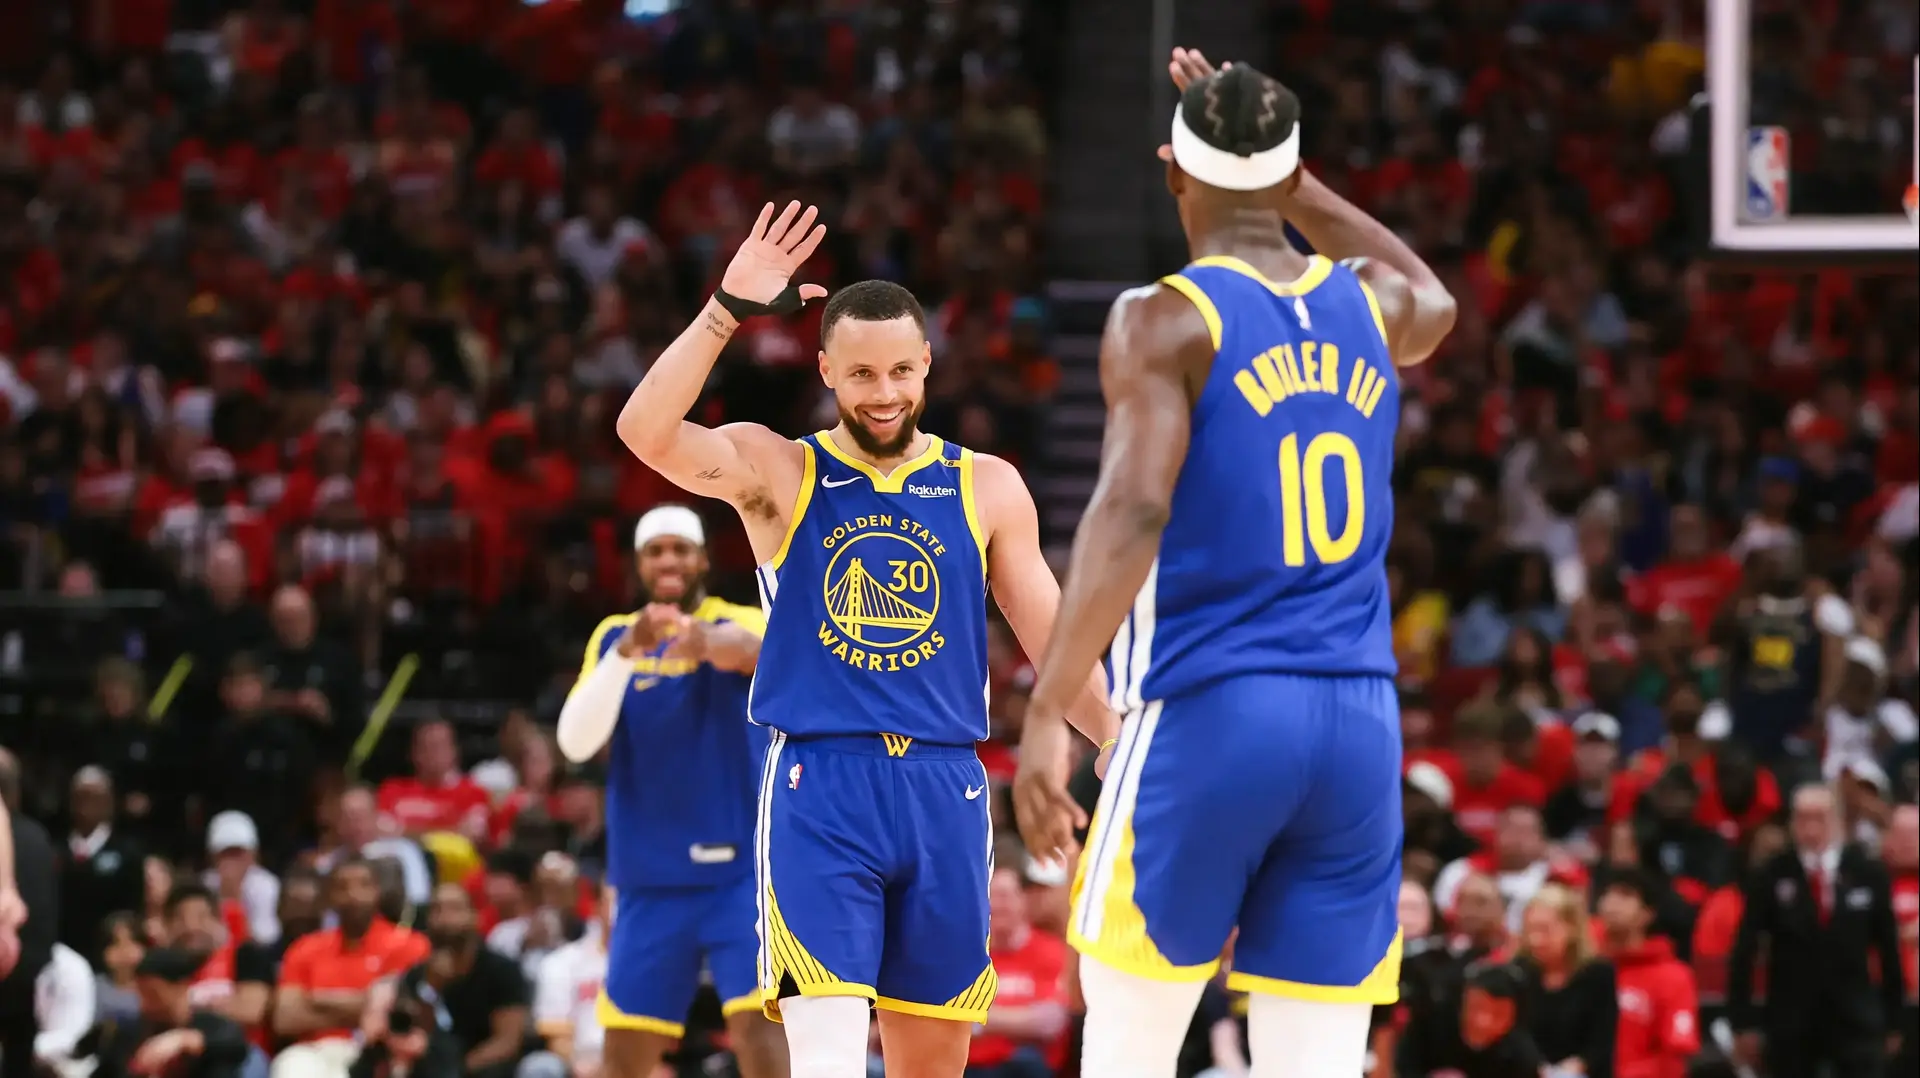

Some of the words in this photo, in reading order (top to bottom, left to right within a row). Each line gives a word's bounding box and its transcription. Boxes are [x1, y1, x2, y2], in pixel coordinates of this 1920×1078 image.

[1233, 341, 1339, 417] BUTLER
[1346, 357, 1387, 418] III
[908, 484, 957, 497] Rakuten
[1278, 431, 1365, 567] 10
[823, 515, 892, 549] GOLDEN
[900, 518, 947, 556] STATE
[887, 560, 929, 593] 30
[818, 620, 945, 672] WARRIORS
